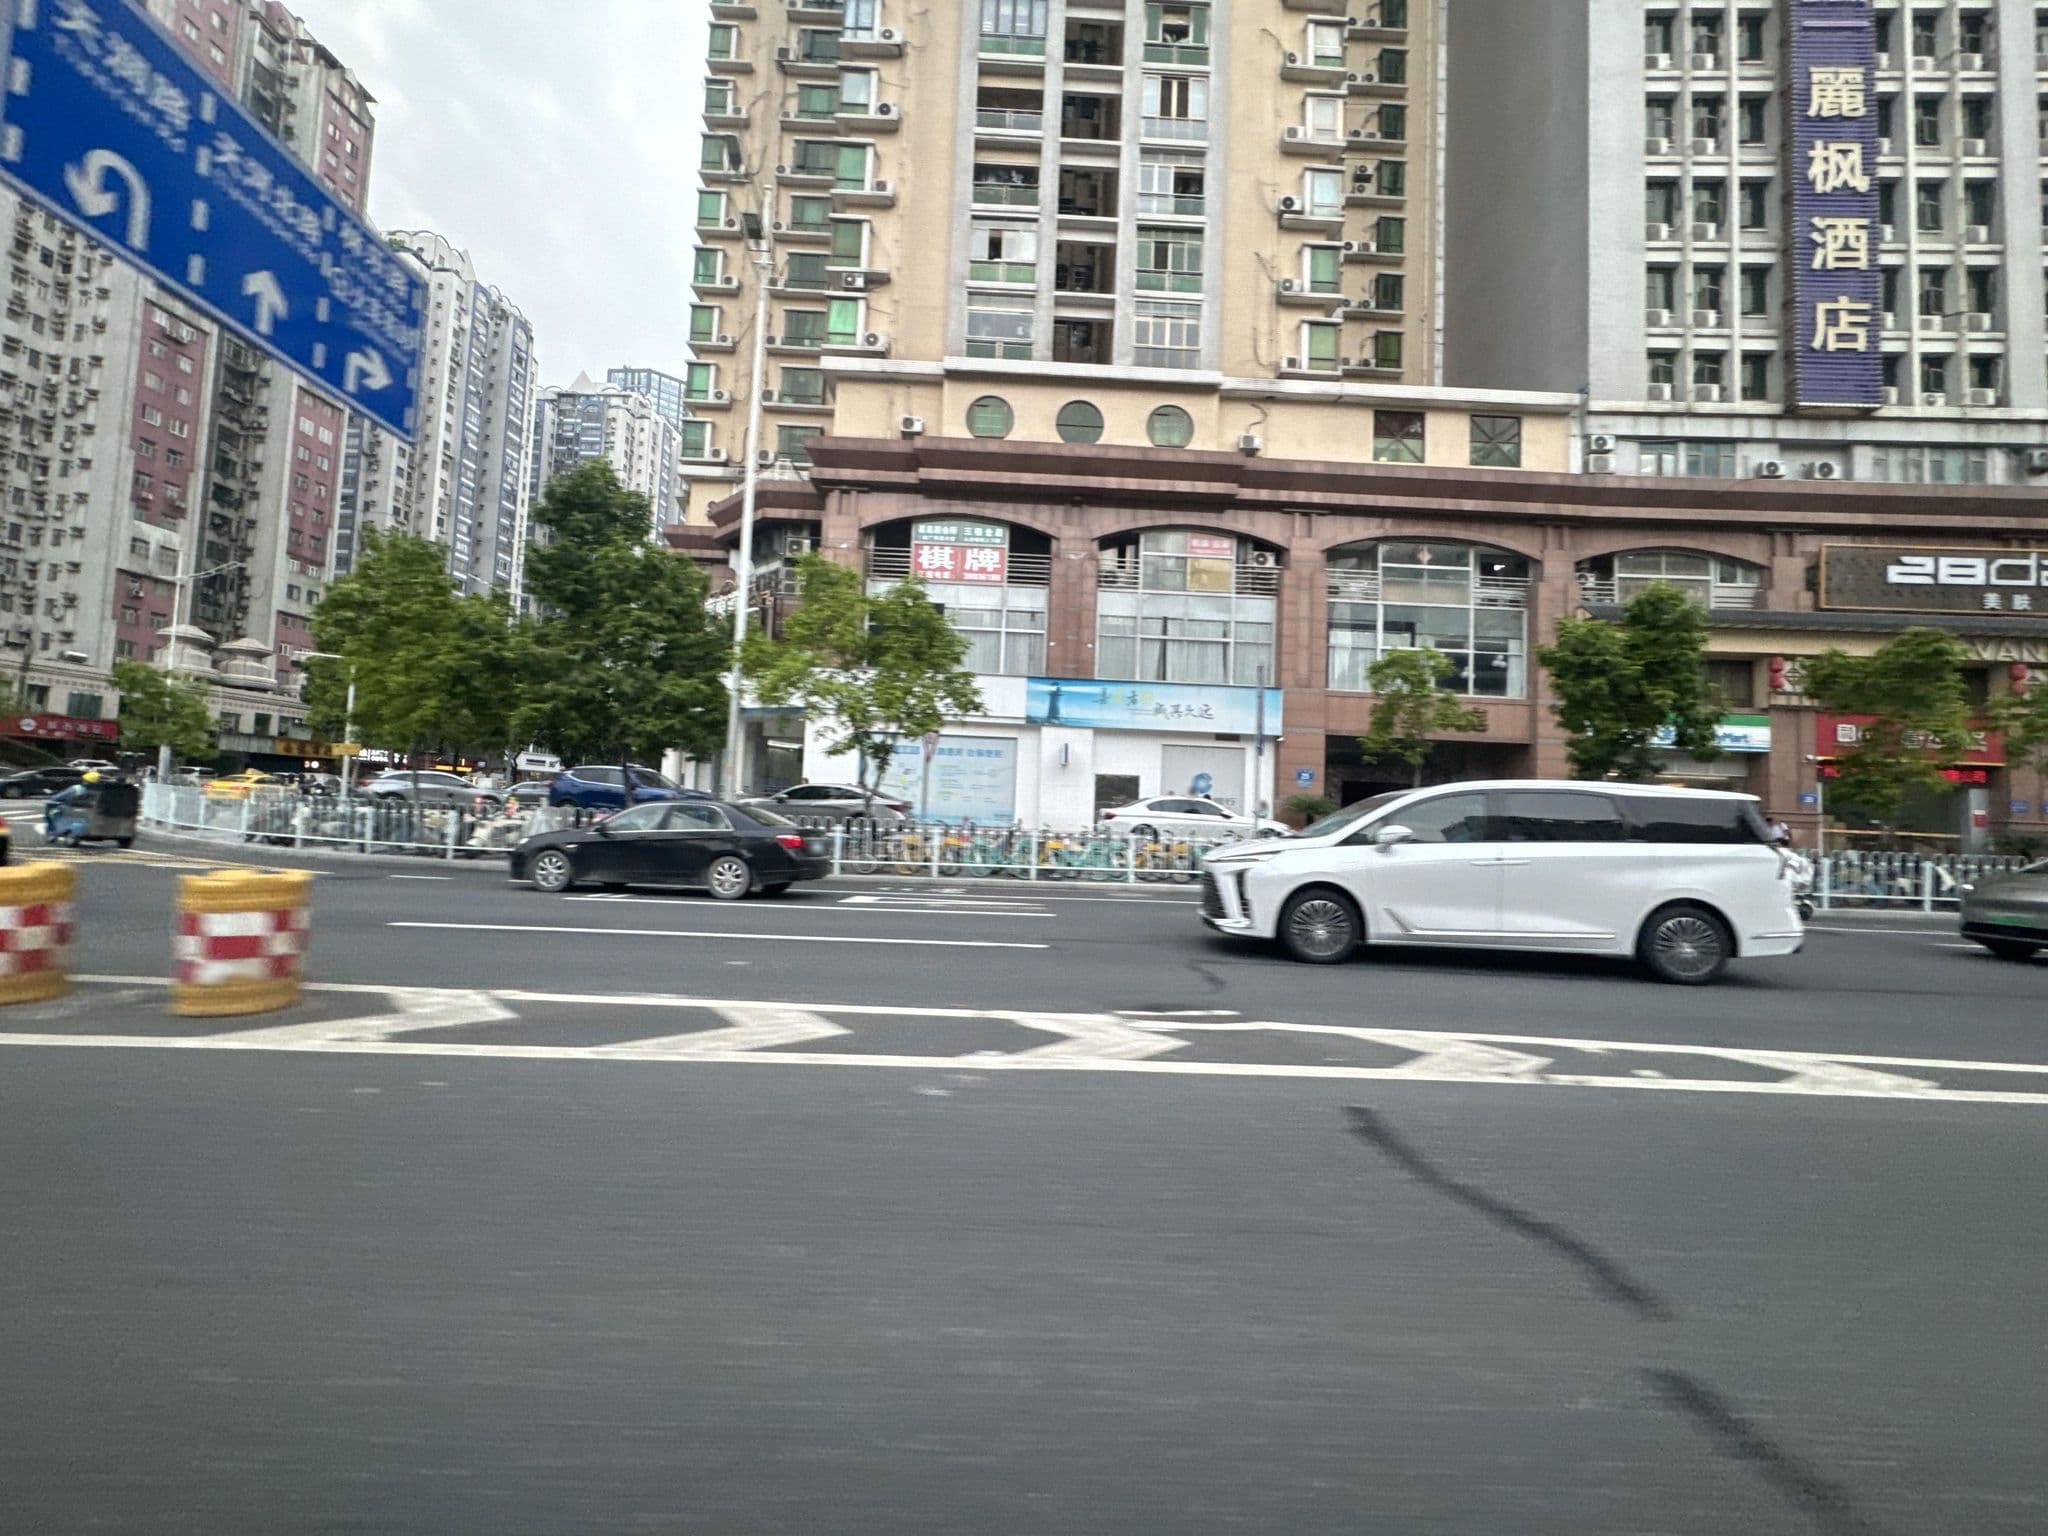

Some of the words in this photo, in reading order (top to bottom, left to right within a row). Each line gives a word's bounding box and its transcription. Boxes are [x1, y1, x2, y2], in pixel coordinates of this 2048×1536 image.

[1807, 67, 1872, 353] 麗枫酒店
[918, 546, 1001, 571] 棋牌
